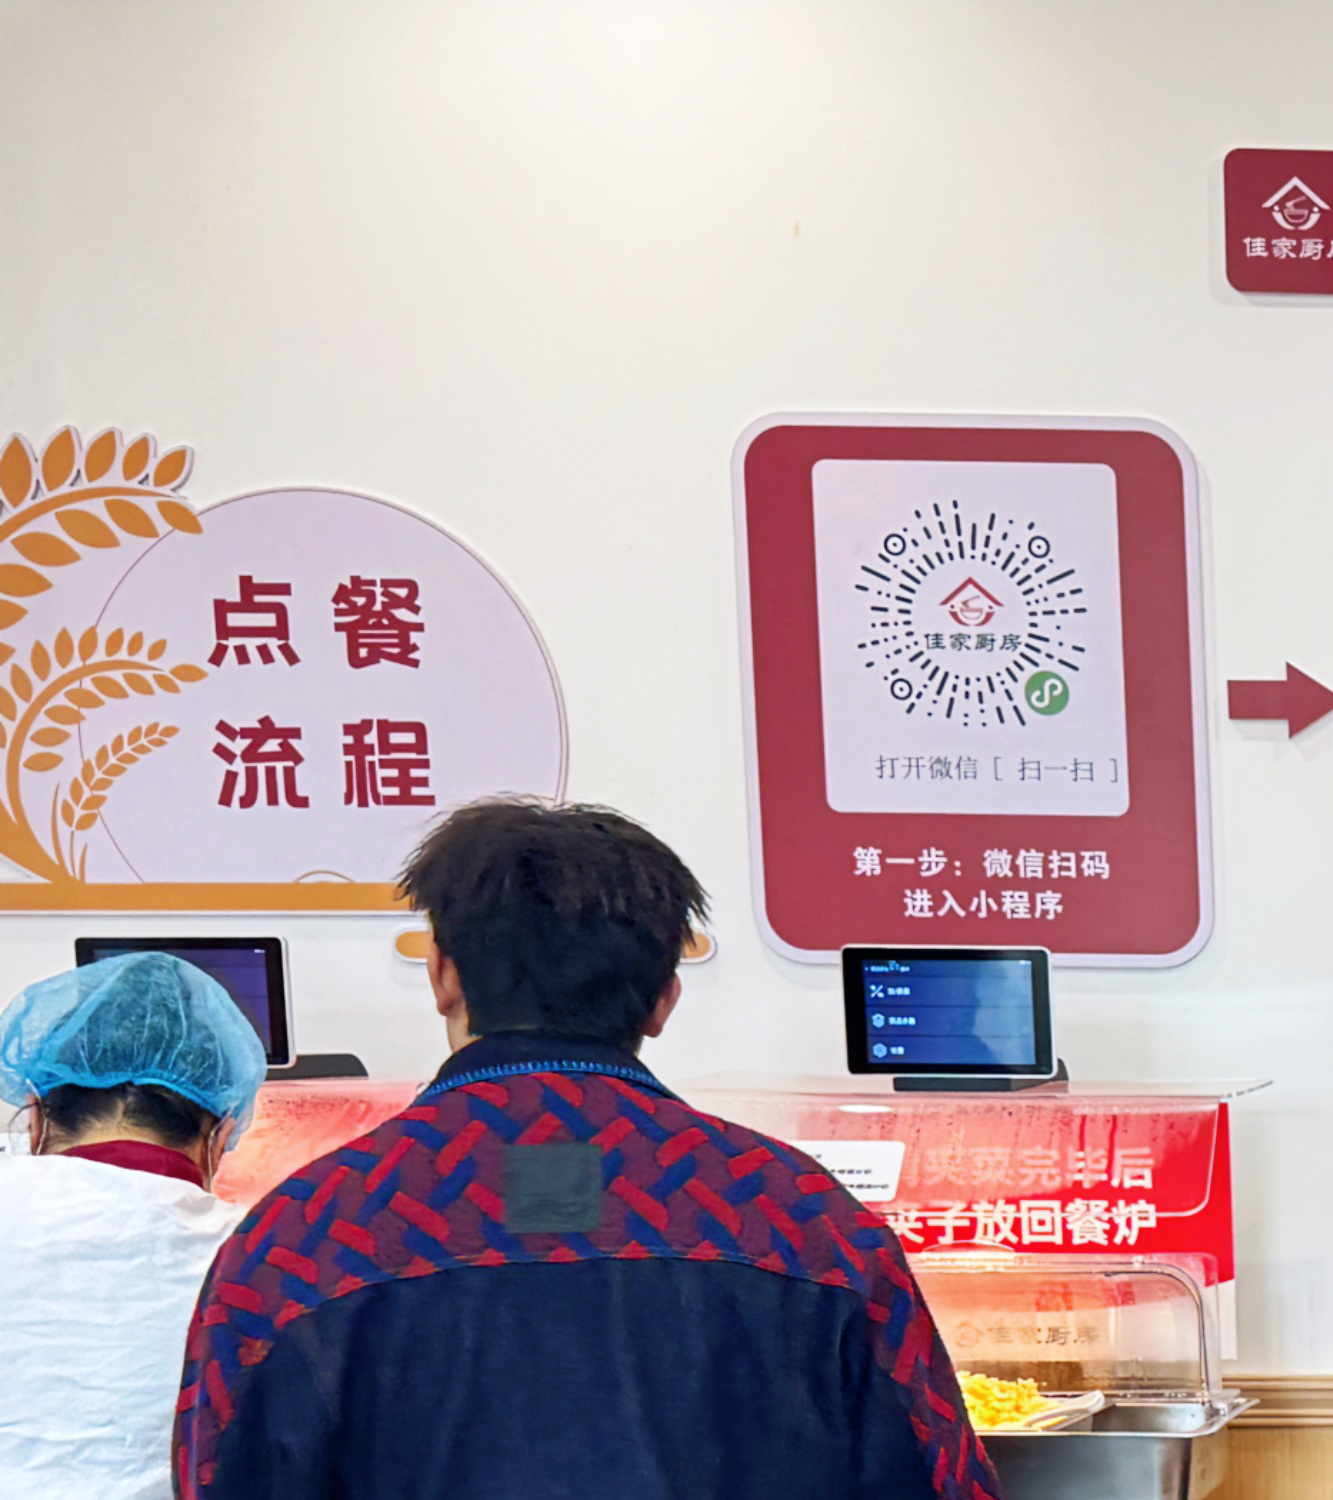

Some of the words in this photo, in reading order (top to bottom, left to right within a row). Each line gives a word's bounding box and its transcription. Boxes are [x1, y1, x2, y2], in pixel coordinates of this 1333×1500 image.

[207, 575, 426, 670] 点餐
[923, 632, 1023, 653] 佳家厨房
[211, 715, 437, 809] 流程
[853, 847, 1111, 879] 第一步：微信扫码
[903, 889, 1064, 920] 进入小程序
